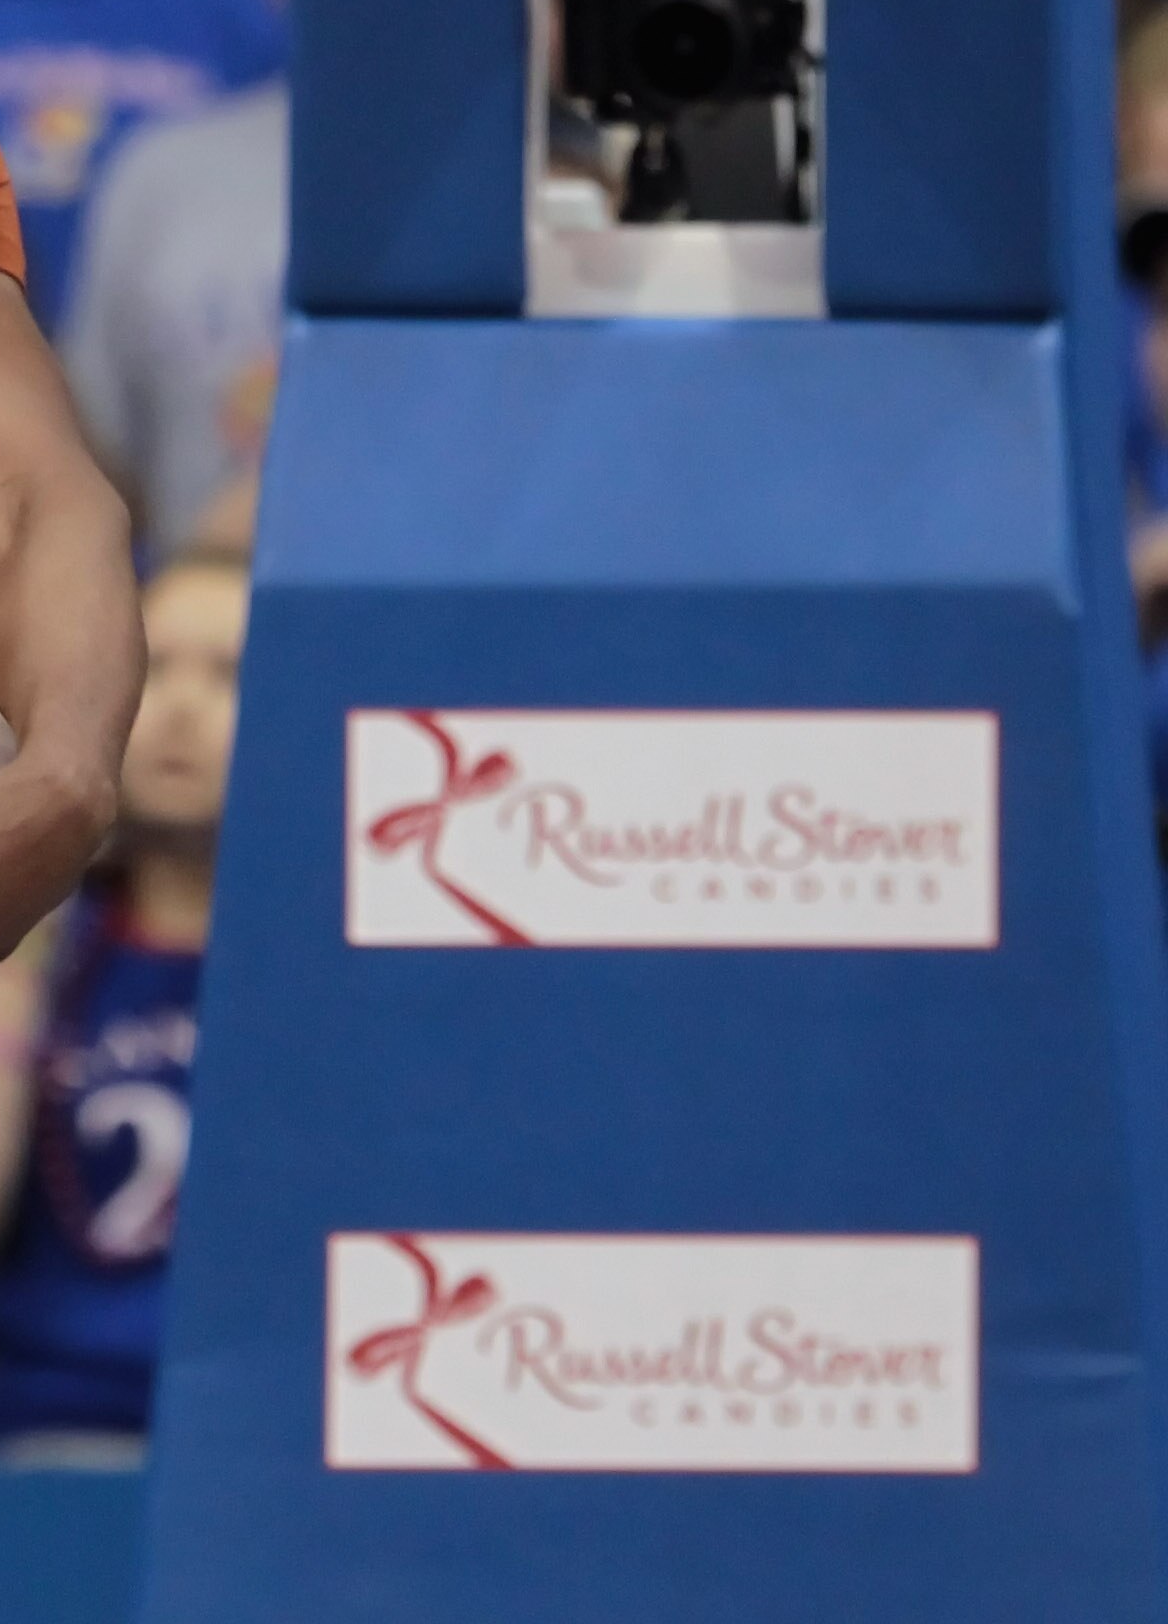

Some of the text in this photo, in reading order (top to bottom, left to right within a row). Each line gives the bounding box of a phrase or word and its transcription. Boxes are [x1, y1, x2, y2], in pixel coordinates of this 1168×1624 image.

[497, 782, 968, 888] Russell Stover
[649, 874, 942, 904] CANDIES
[476, 1306, 948, 1412] Russell Stover
[631, 1398, 921, 1428] CANDIES
